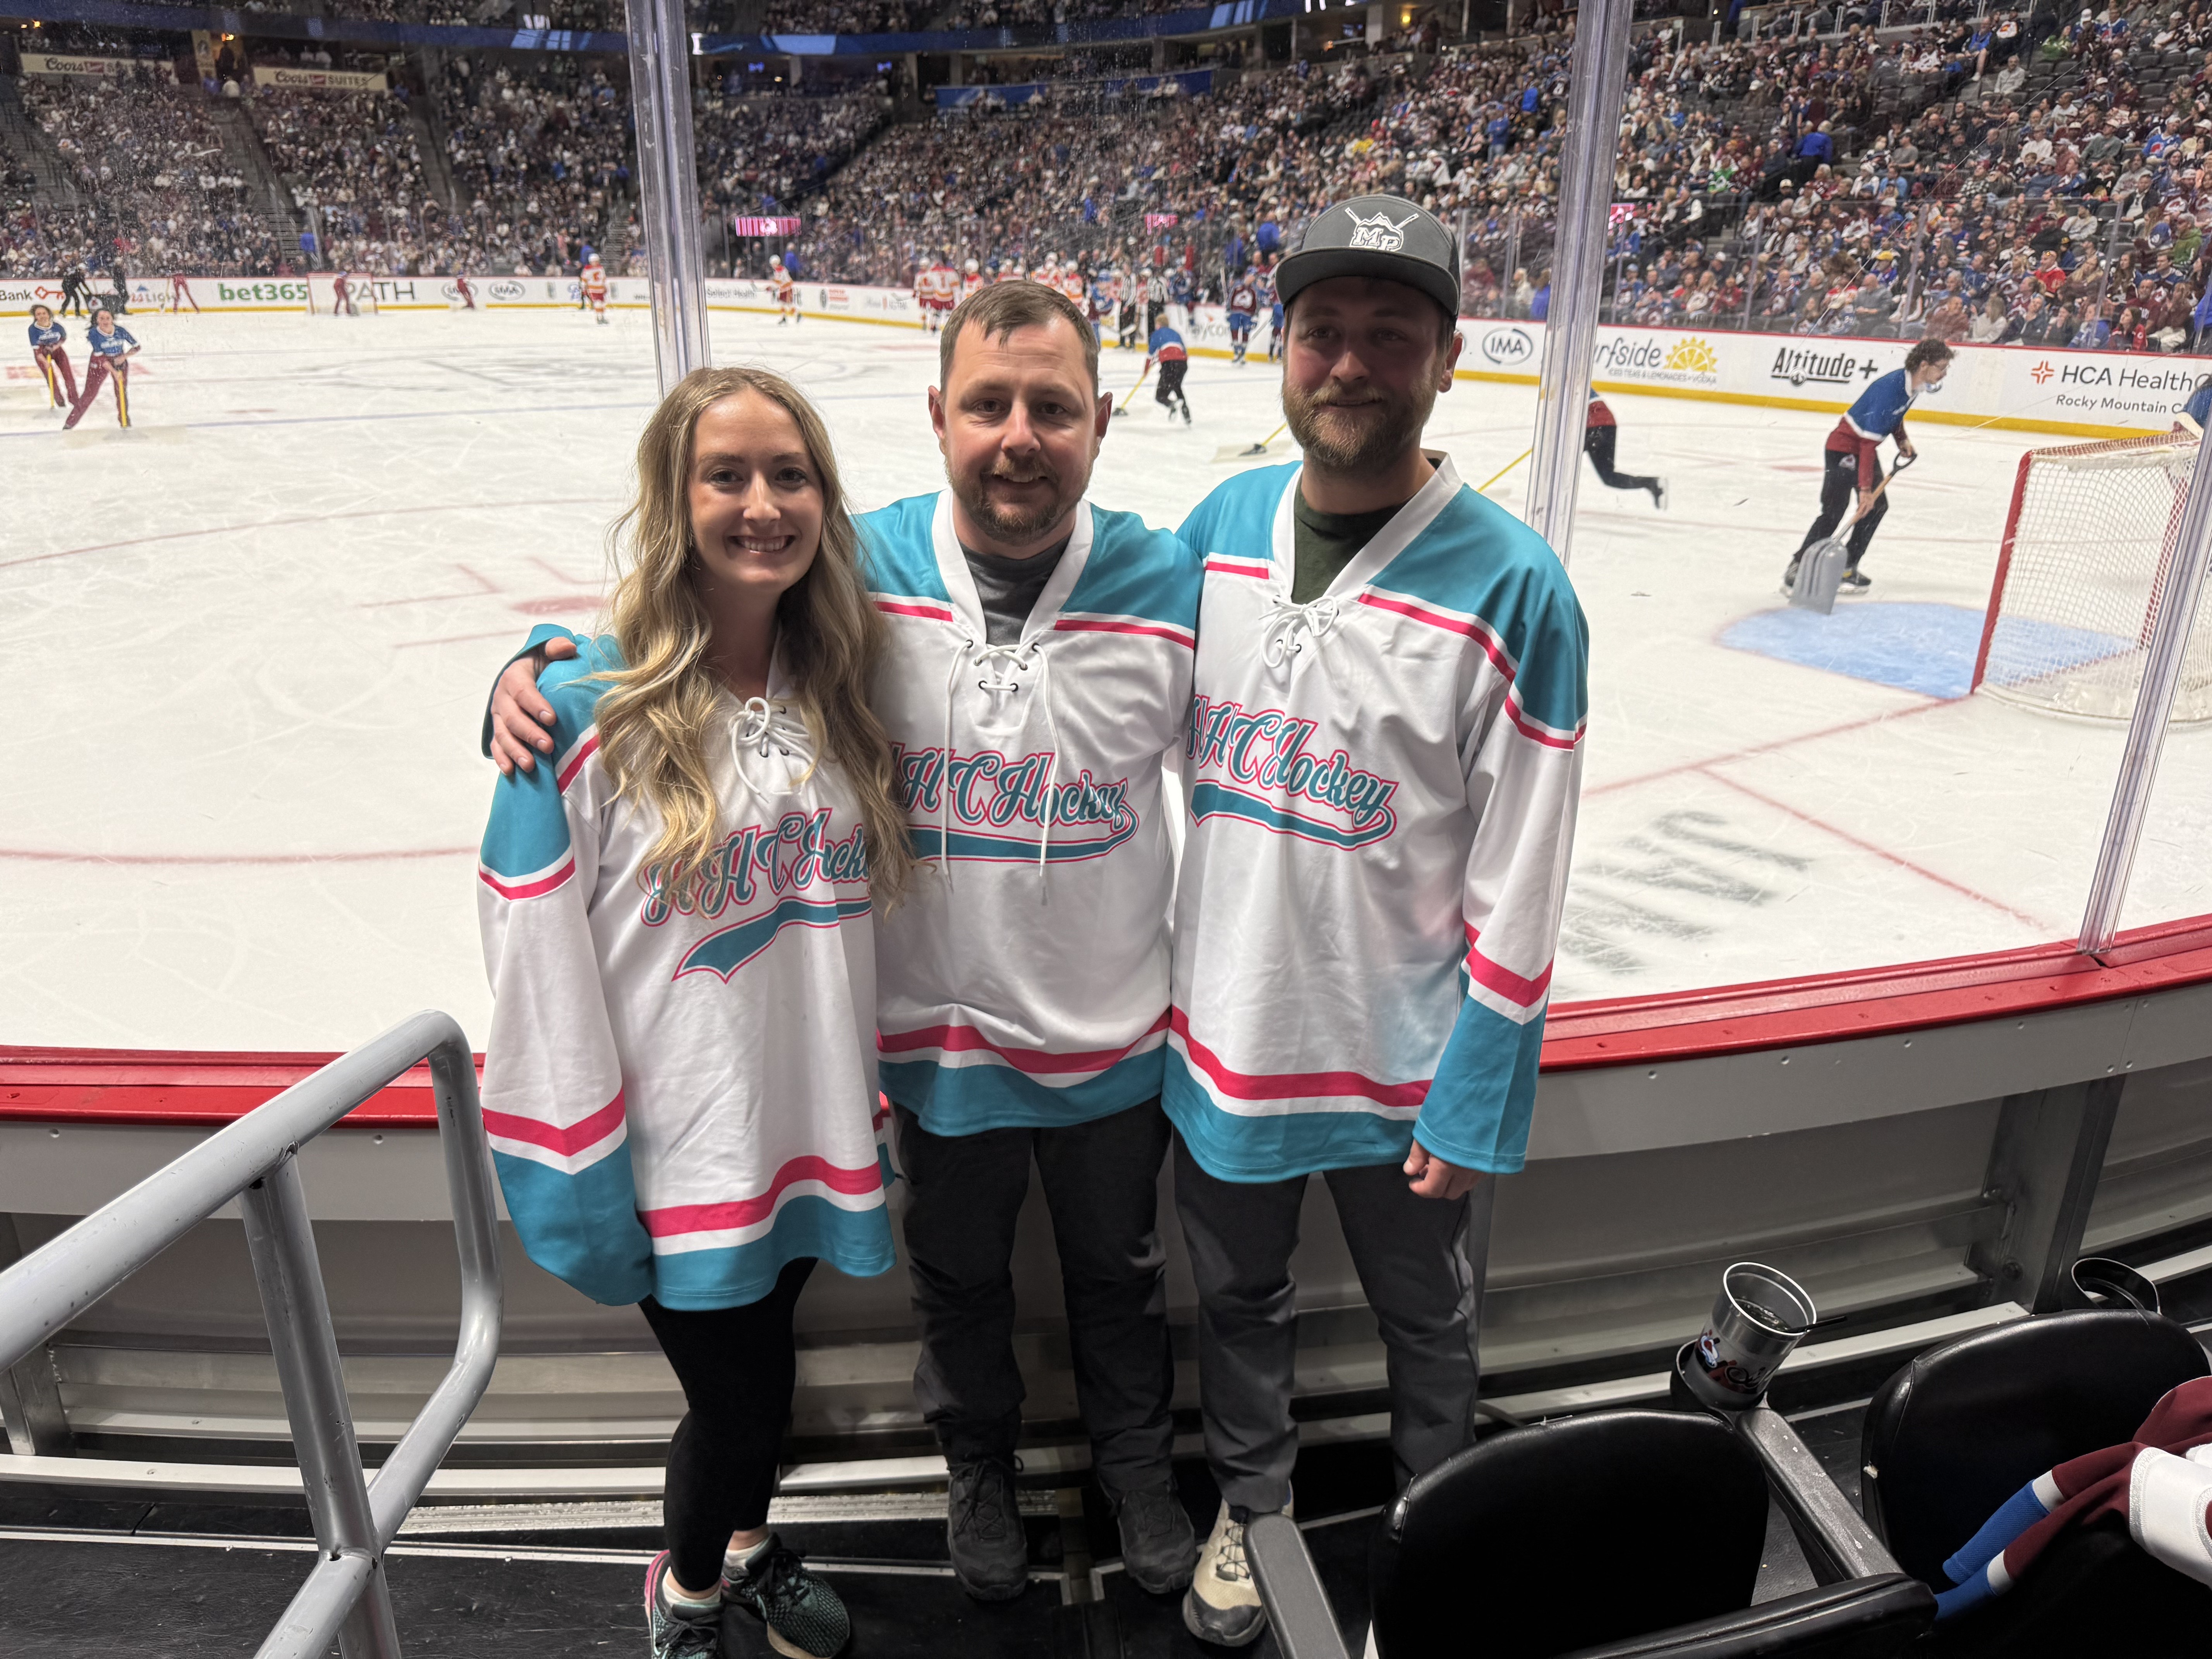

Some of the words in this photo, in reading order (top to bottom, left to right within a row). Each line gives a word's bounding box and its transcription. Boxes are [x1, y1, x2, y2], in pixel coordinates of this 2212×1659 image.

[44, 57, 84, 71] Coors
[274, 70, 308, 84] Coors
[328, 76, 368, 85] SUITES
[1352, 227, 1401, 250] MP
[0, 289, 33, 301] Bank
[219, 282, 309, 301] bet365
[347, 282, 416, 301] PATH
[1491, 337, 1524, 355] IMA
[1772, 347, 1856, 378] Altitude
[2061, 365, 2112, 385] HCA
[2056, 394, 2097, 410] Rocky
[2100, 397, 2167, 414] Mountain
